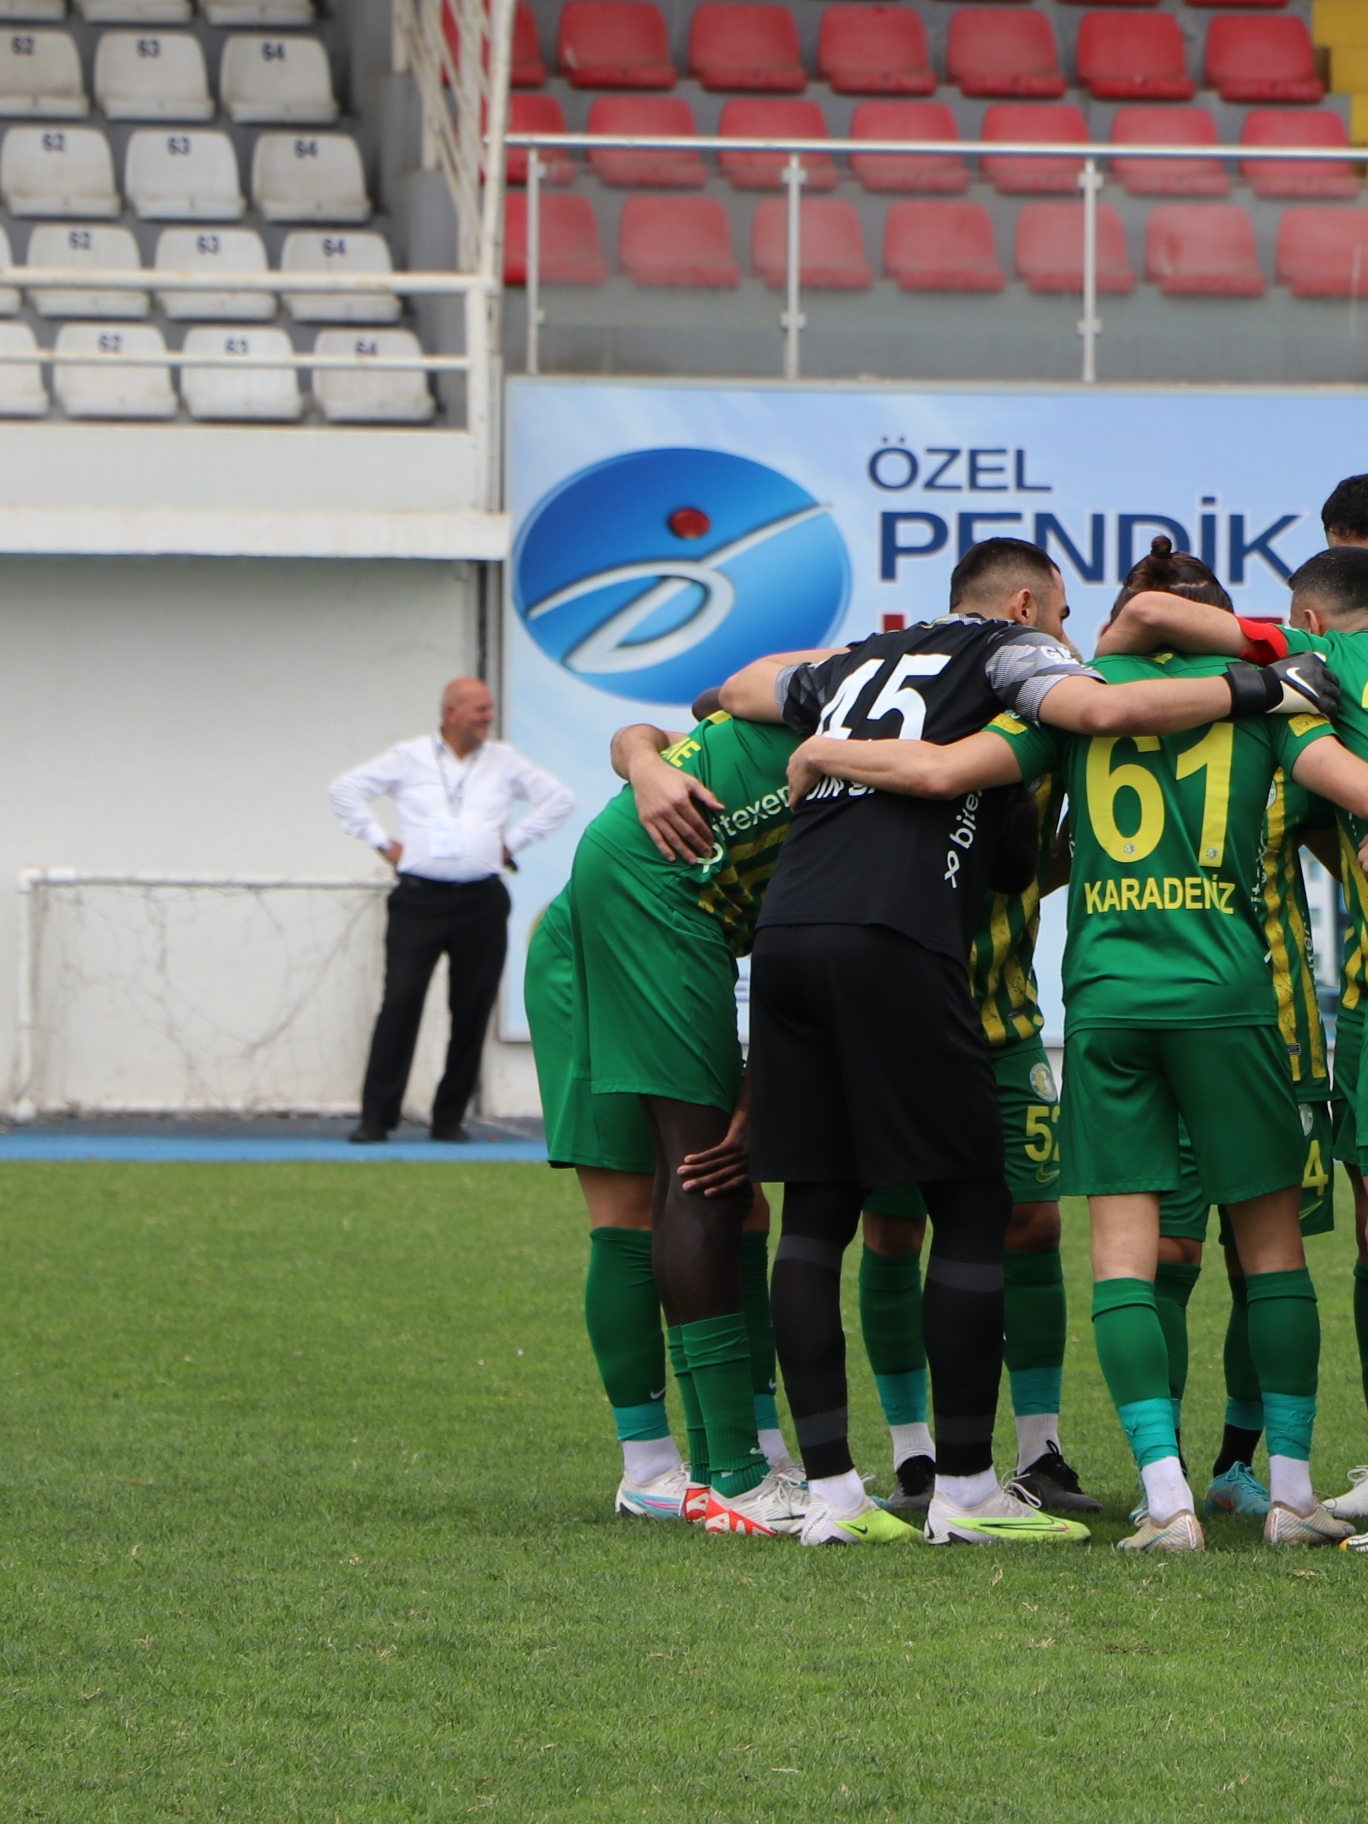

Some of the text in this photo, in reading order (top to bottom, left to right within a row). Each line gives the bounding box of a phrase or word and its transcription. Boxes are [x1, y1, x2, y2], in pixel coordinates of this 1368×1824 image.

[12, 36, 34, 56] 62
[137, 39, 161, 58] 63
[262, 43, 285, 61] 64
[43, 133, 66, 152] 62
[167, 136, 190, 156] 63
[294, 140, 318, 158] 64
[69, 231, 92, 250] 62
[197, 235, 220, 254] 63
[323, 238, 346, 257] 64
[868, 436, 1053, 493] ÖZEL
[1086, 722, 1234, 867] 61
